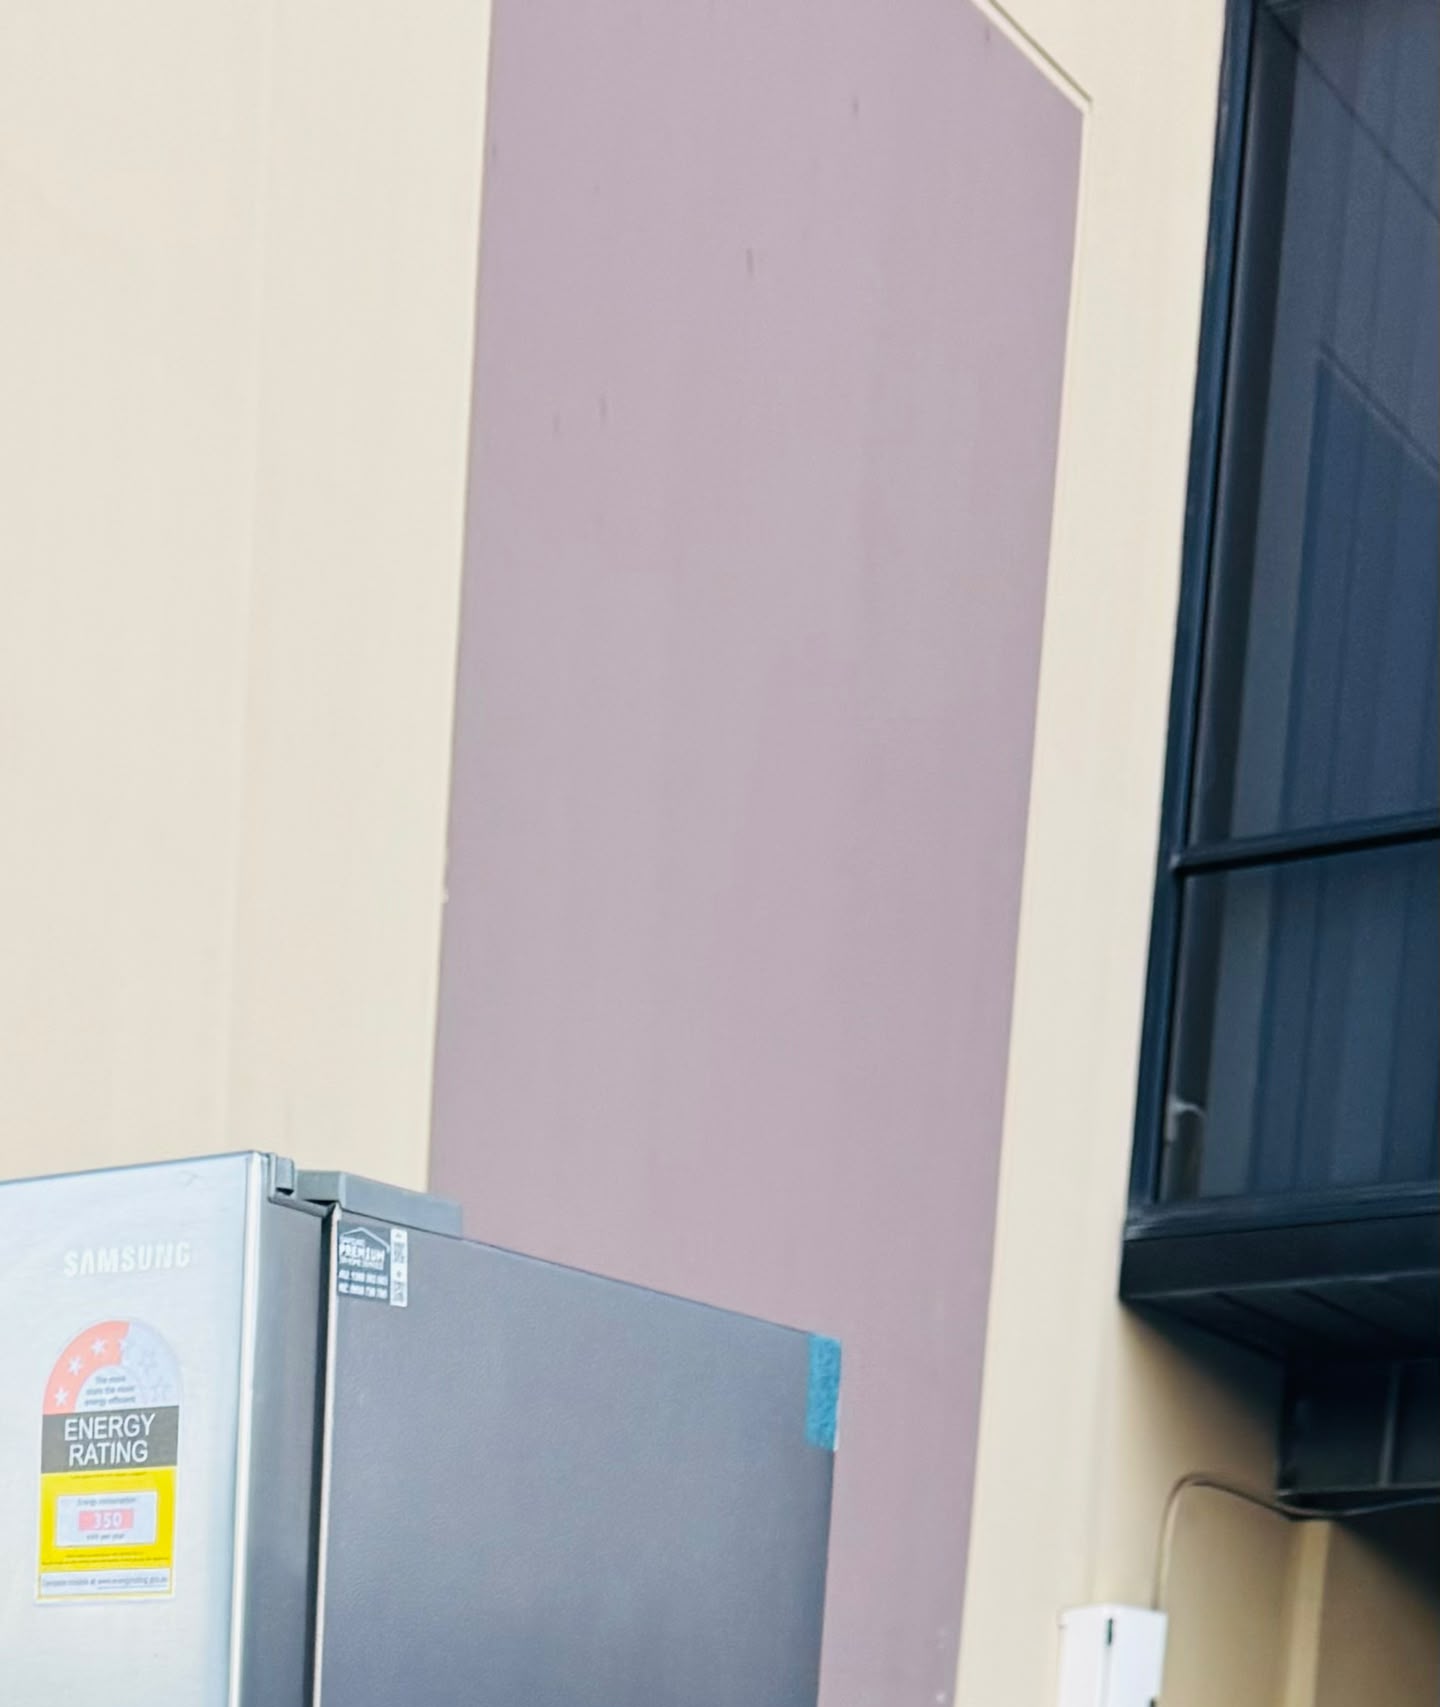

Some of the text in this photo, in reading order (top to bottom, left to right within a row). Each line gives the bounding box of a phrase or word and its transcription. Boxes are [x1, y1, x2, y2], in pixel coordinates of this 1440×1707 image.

[63, 1241, 191, 1277] SAMSUNG
[64, 1413, 156, 1442] ENERGY
[68, 1440, 149, 1467] RATING
[94, 1511, 122, 1529] 350
